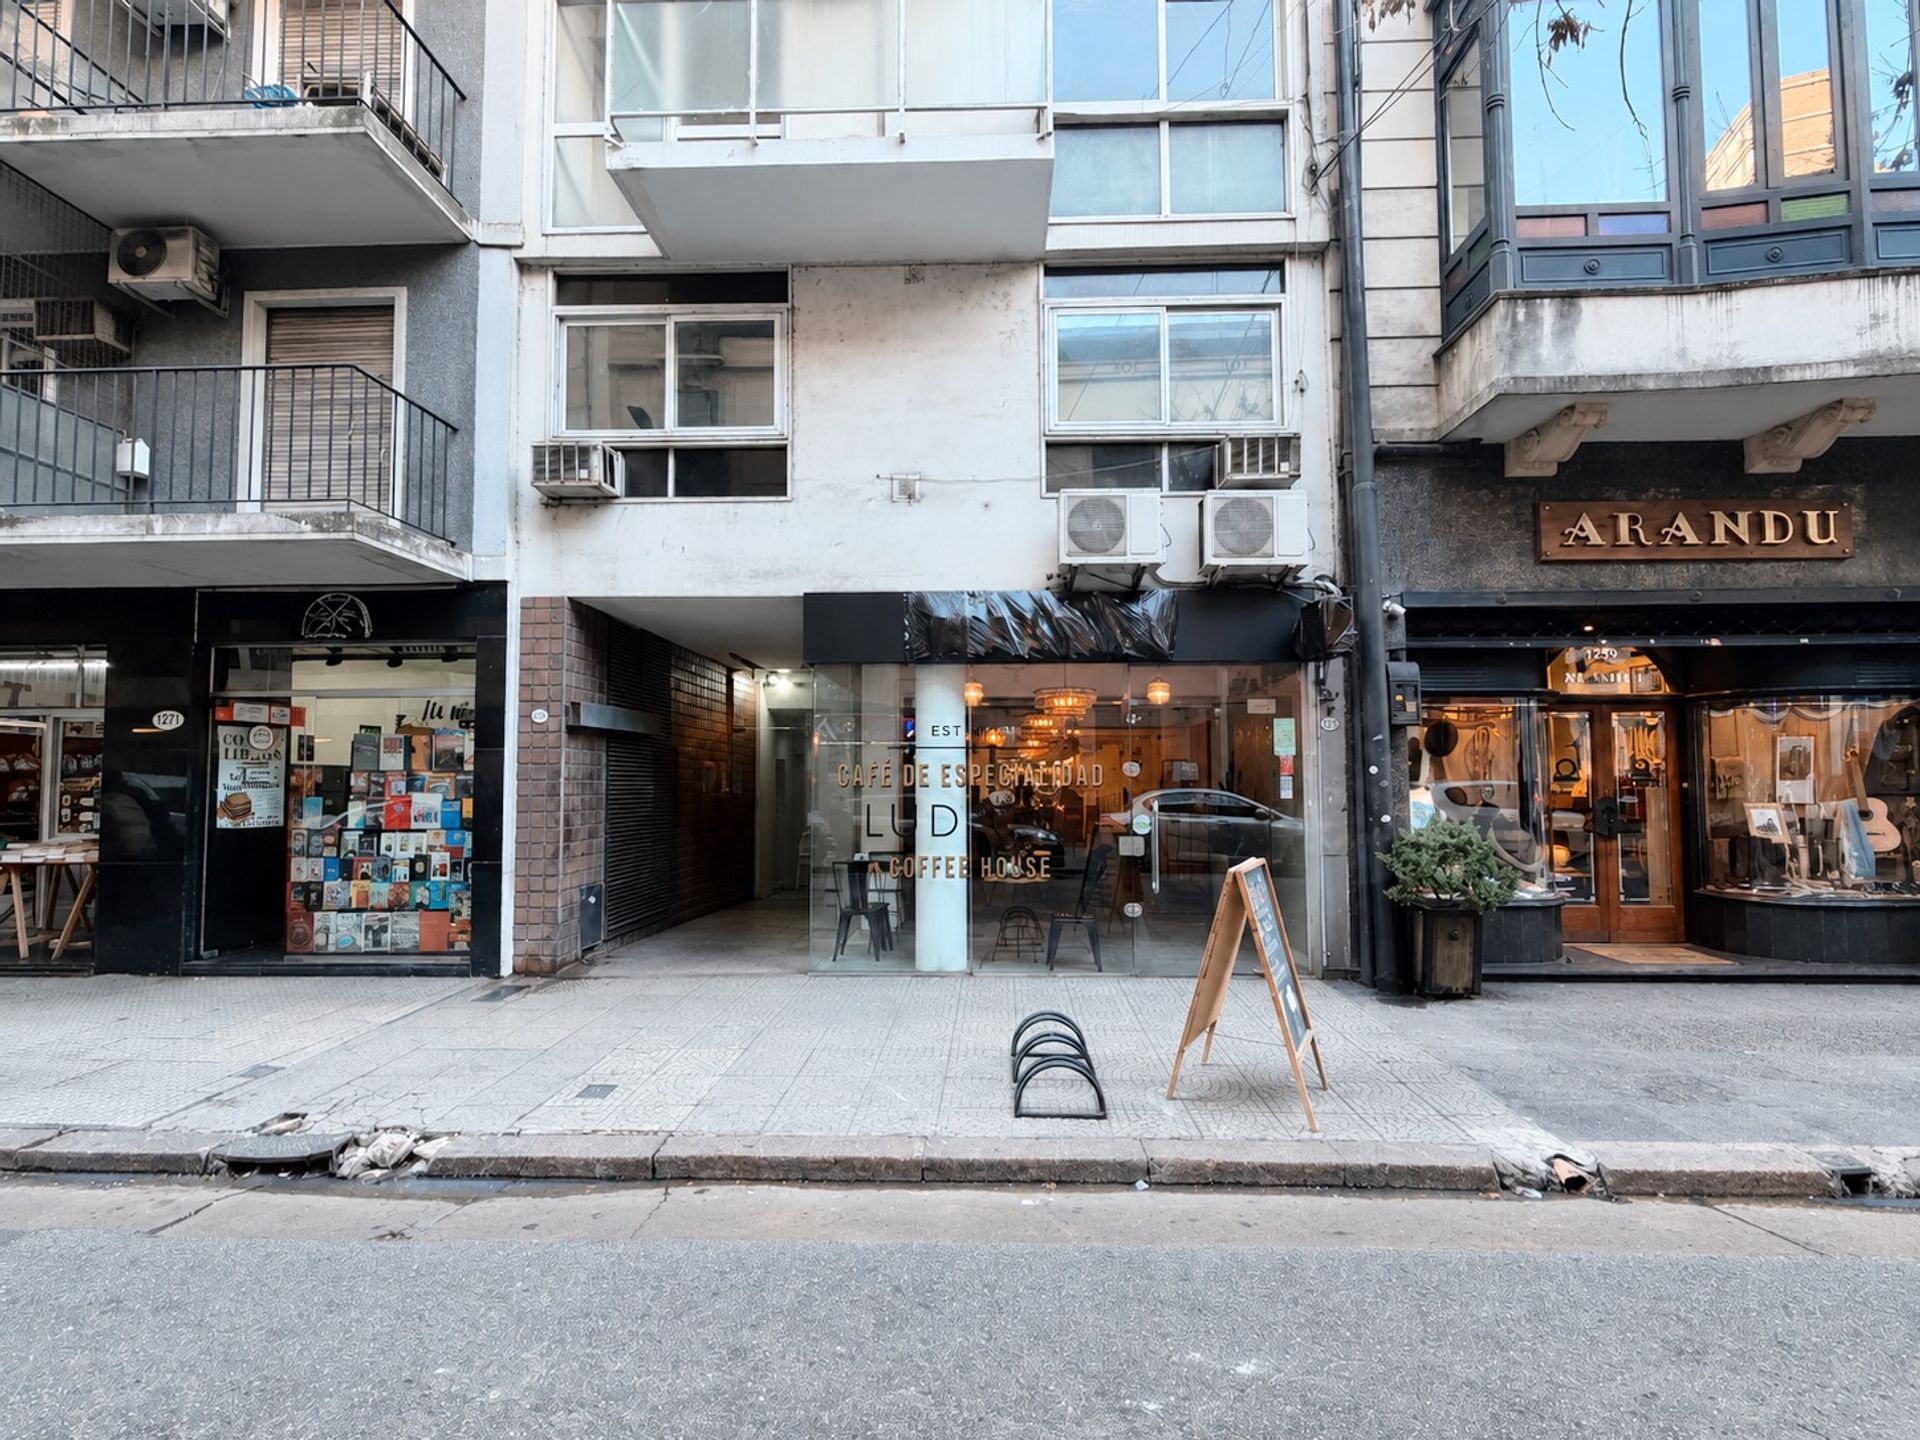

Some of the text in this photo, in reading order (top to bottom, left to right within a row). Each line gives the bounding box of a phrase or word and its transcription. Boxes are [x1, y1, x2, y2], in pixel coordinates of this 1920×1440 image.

[1560, 509, 1840, 546] ARANDU
[157, 713, 180, 726] 1271
[931, 724, 961, 737] EST
[837, 759, 1104, 788] CAFÉ DE ESPECIALIDAD
[889, 855, 1051, 879] COFFEE HOUSE
